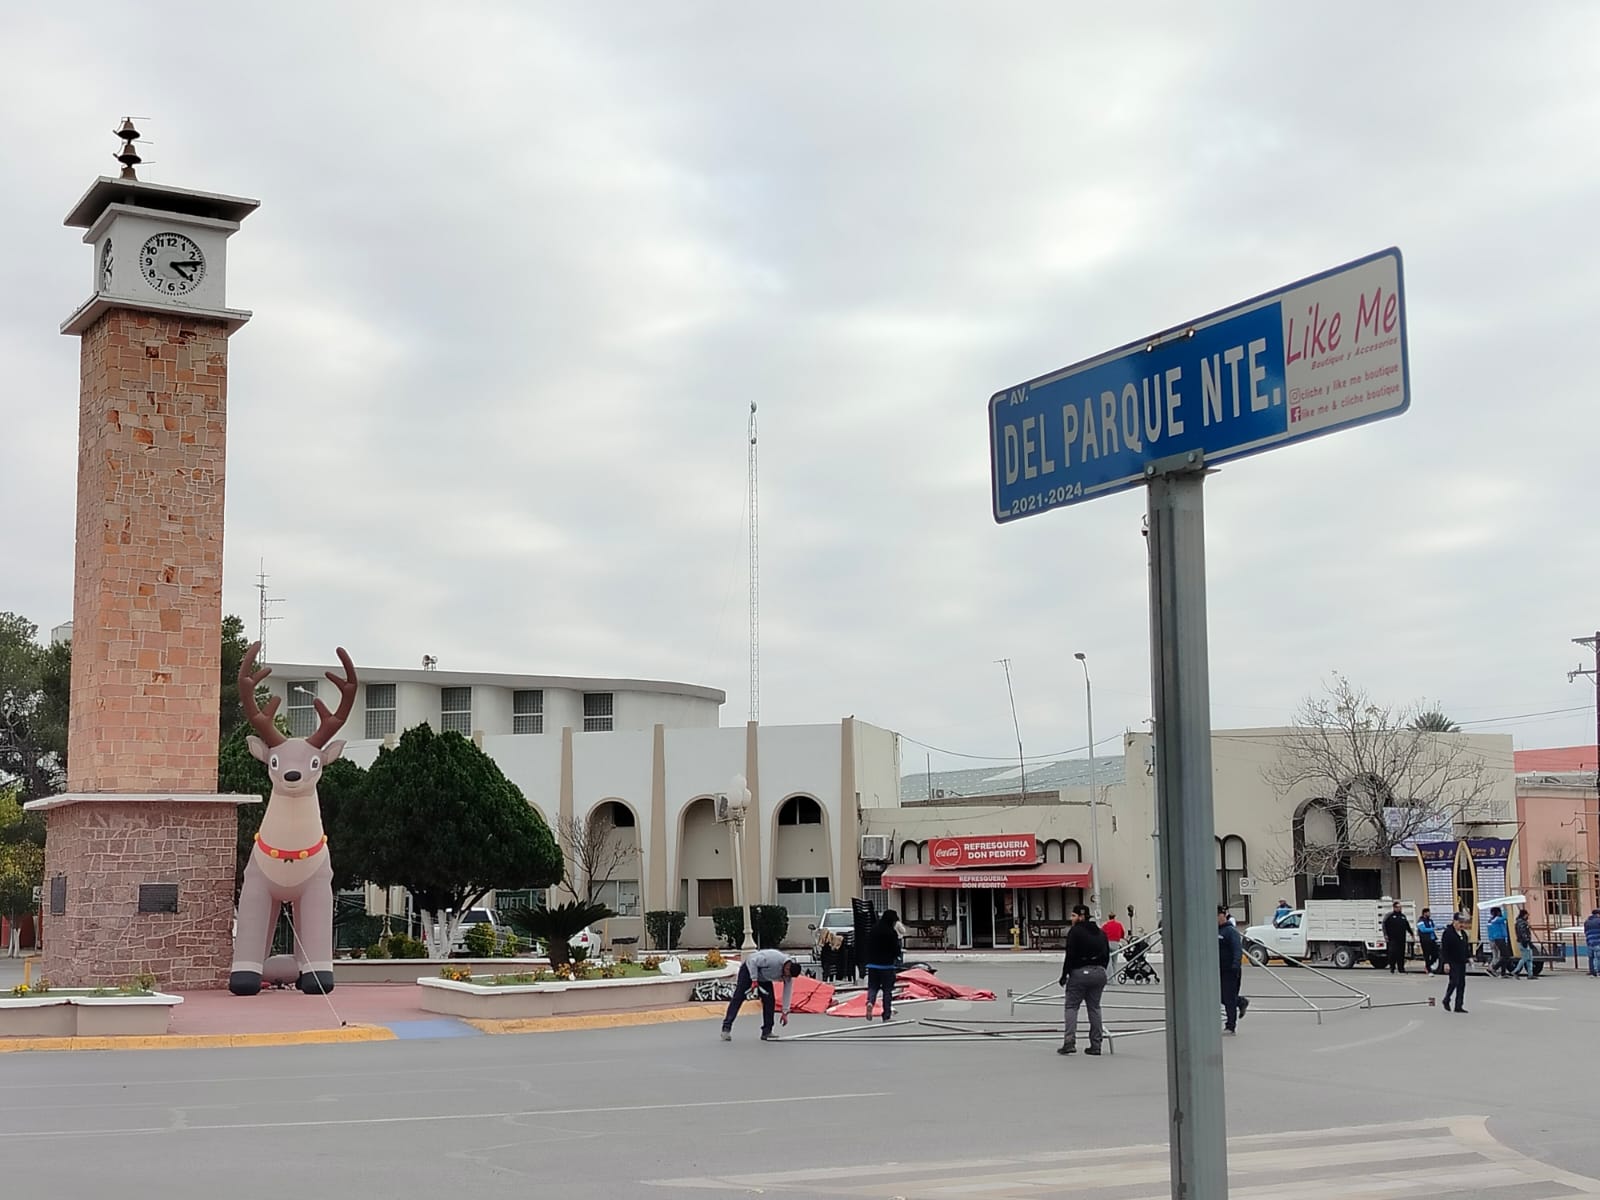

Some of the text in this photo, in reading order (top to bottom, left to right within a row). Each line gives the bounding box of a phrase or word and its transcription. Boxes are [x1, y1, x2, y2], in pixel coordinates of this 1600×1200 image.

[156, 238, 165, 248] 11
[167, 238, 178, 248] 12
[181, 242, 186, 252] 1
[146, 246, 158, 255] 10
[189, 251, 196, 261] 2
[145, 257, 153, 266] 9
[148, 269, 156, 278] 8
[157, 278, 164, 288] 7
[167, 282, 175, 291] 6
[179, 281, 186, 290] 5
[1286, 287, 1397, 366] Like Me
[1311, 354, 1344, 370] Boutique
[1332, 379, 1347, 391] like
[1350, 375, 1362, 385] me
[1364, 364, 1398, 381] boutique
[1010, 387, 1029, 406] AV.
[1302, 407, 1315, 419] like
[1317, 405, 1328, 414] me
[1366, 383, 1399, 399] boutique
[1004, 337, 1281, 485] DEL PARQUE NTE.
[963, 840, 1029, 851] REFRESQUERIA
[968, 849, 1026, 860] DON PEDRITO
